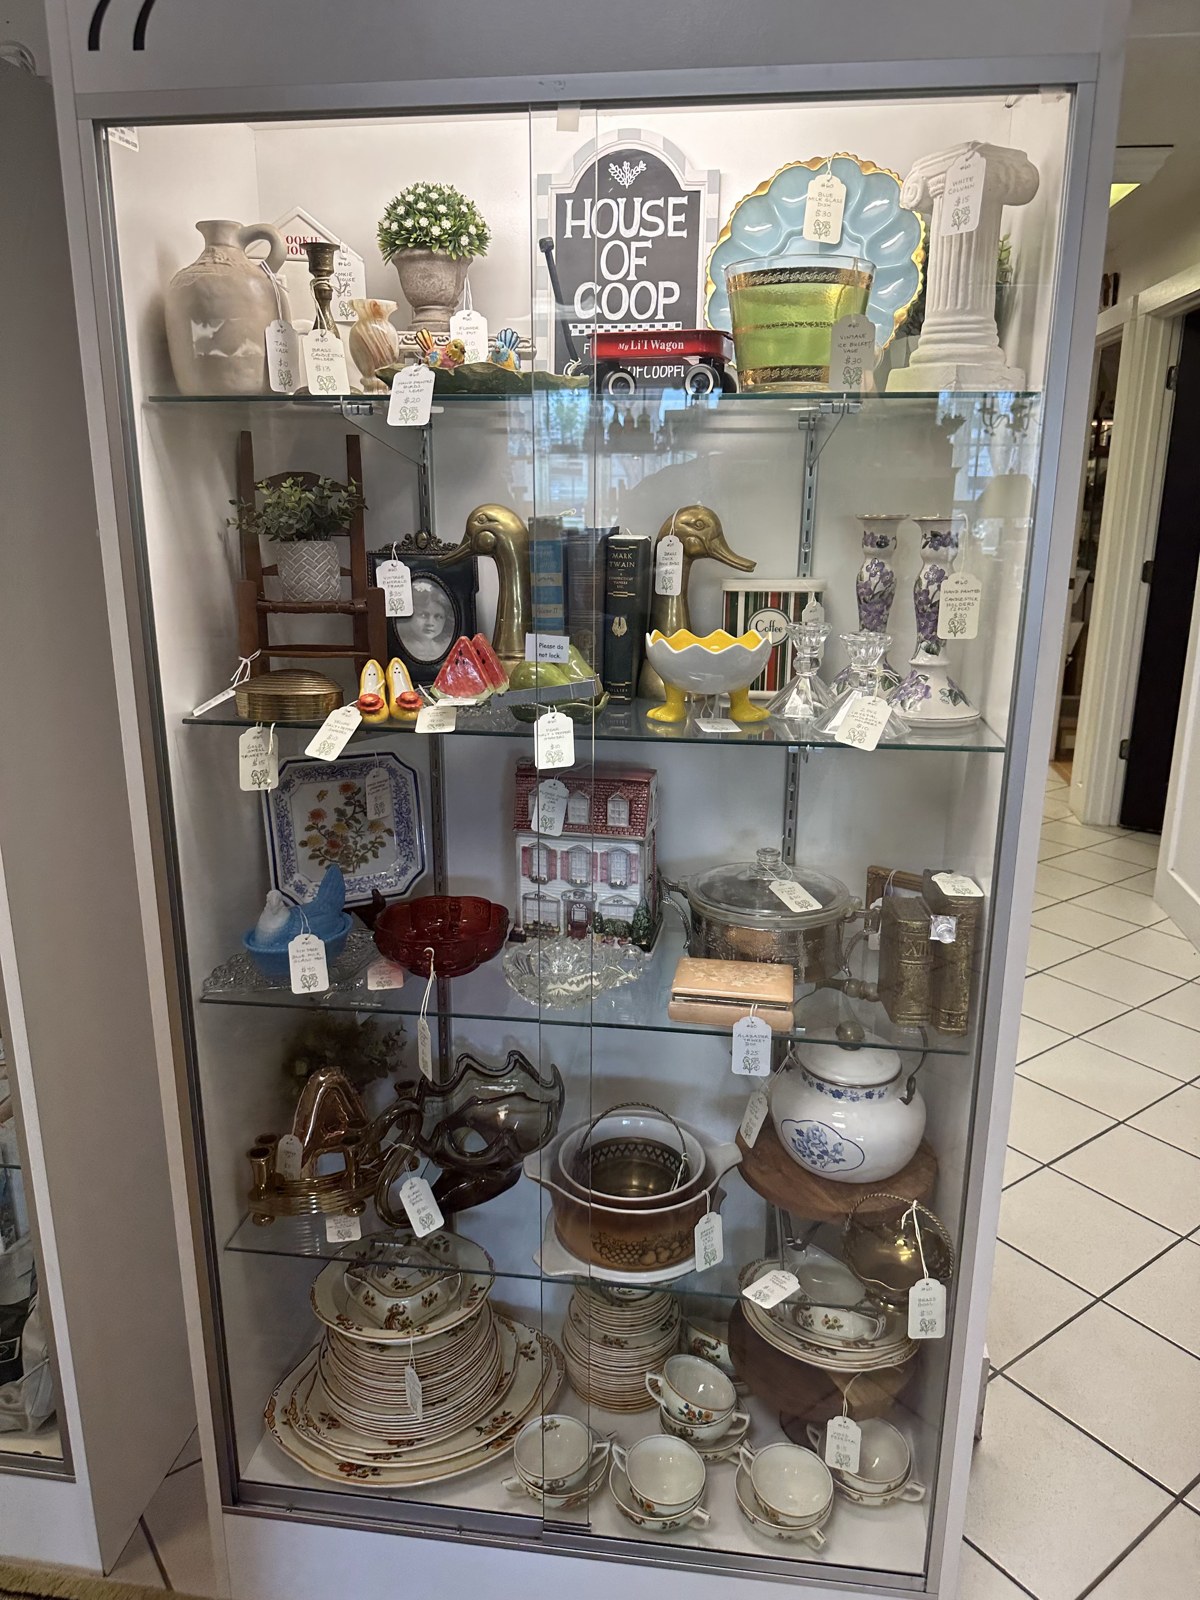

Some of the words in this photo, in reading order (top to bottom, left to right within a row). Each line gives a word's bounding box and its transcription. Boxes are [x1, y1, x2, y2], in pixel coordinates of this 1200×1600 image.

[952, 176, 974, 187] WHITE
[563, 195, 689, 239] HOUSE
[286, 235, 321, 244] OOKIE
[600, 240, 652, 281] OF
[574, 280, 681, 320] COOP
[617, 342, 629, 351] My
[650, 340, 685, 351] Wagon
[845, 356, 862, 365] $30
[755, 619, 783, 633] Coffee
